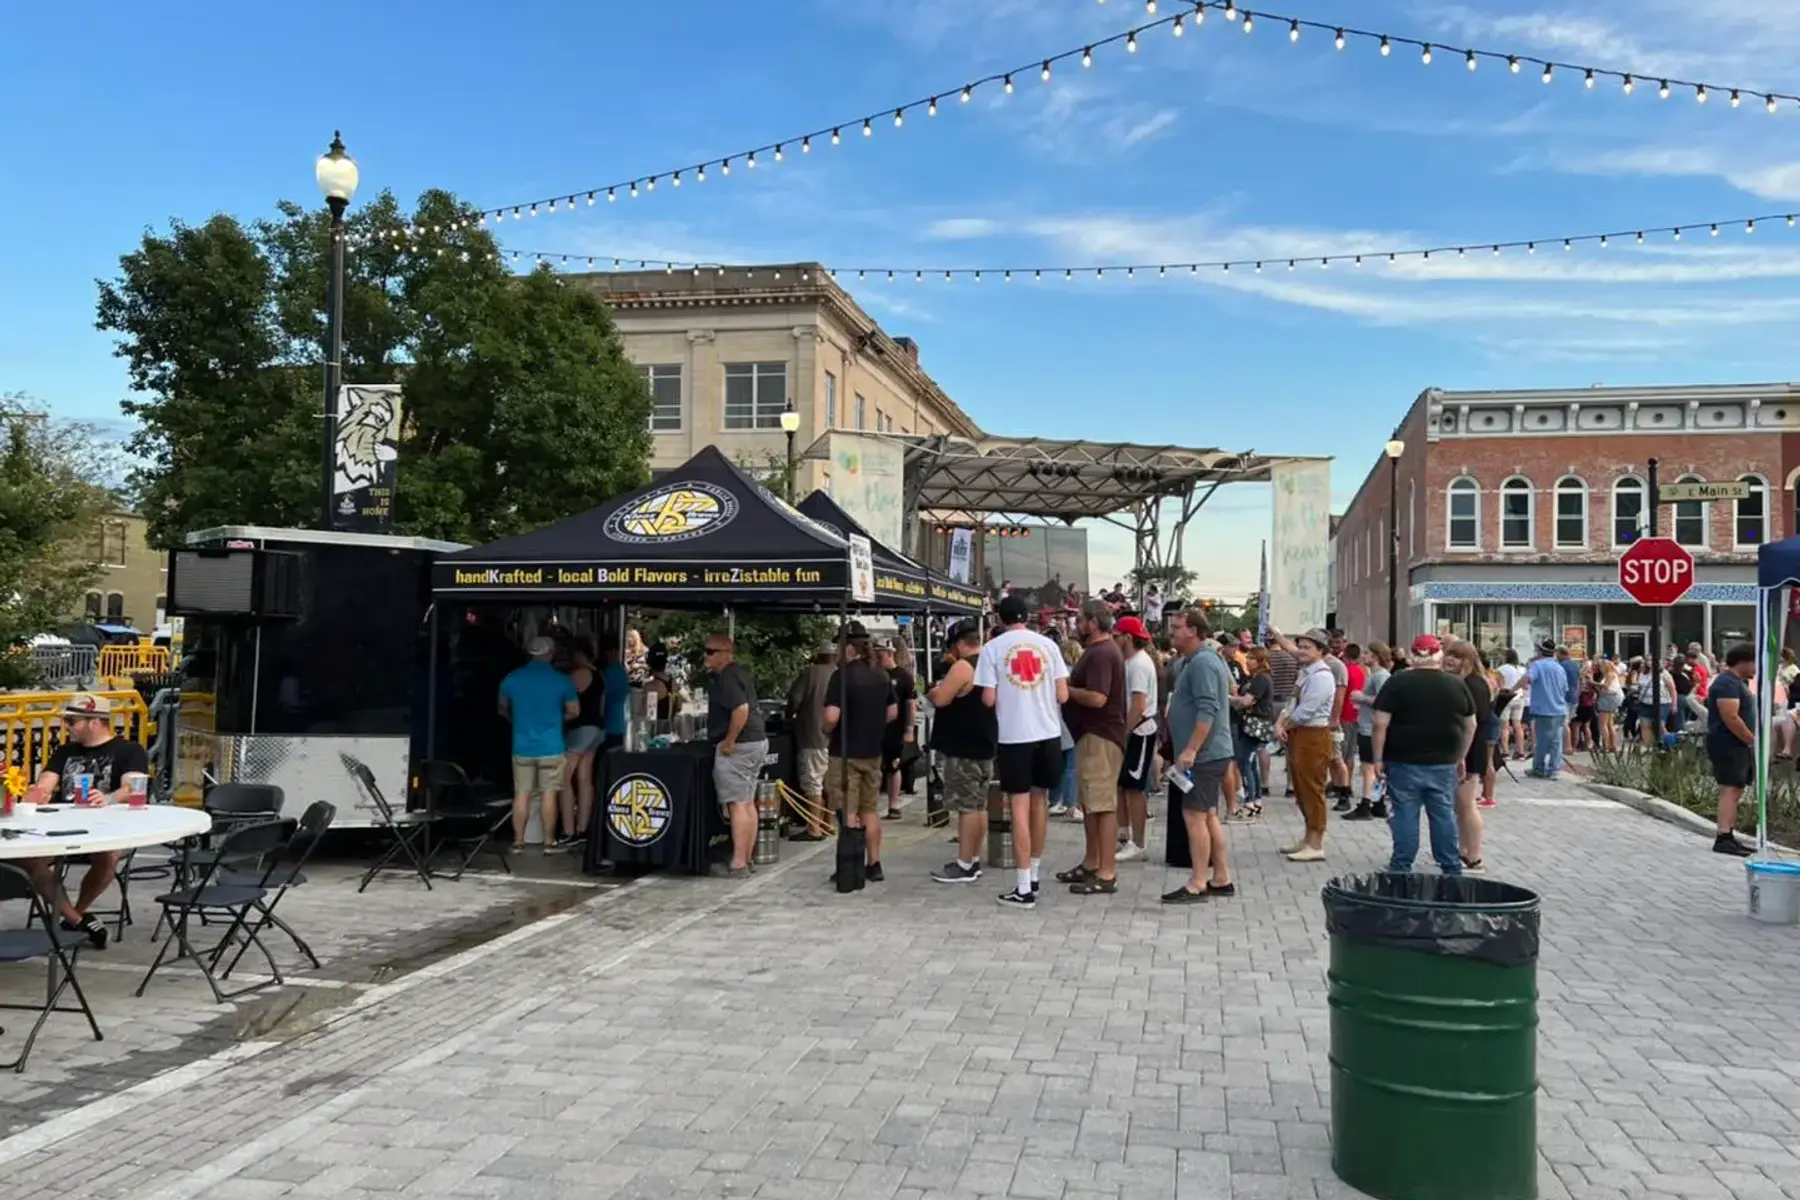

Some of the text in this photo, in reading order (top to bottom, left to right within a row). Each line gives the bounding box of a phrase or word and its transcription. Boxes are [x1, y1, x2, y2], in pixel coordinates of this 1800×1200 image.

[1698, 486, 1729, 497] Main
[455, 569, 542, 584] handKrafted
[558, 568, 593, 583] local
[597, 568, 629, 583] Bold
[634, 568, 688, 583] Flavors
[704, 568, 790, 583] irreZistable
[796, 567, 821, 582] fun
[1624, 559, 1688, 584] STOP
